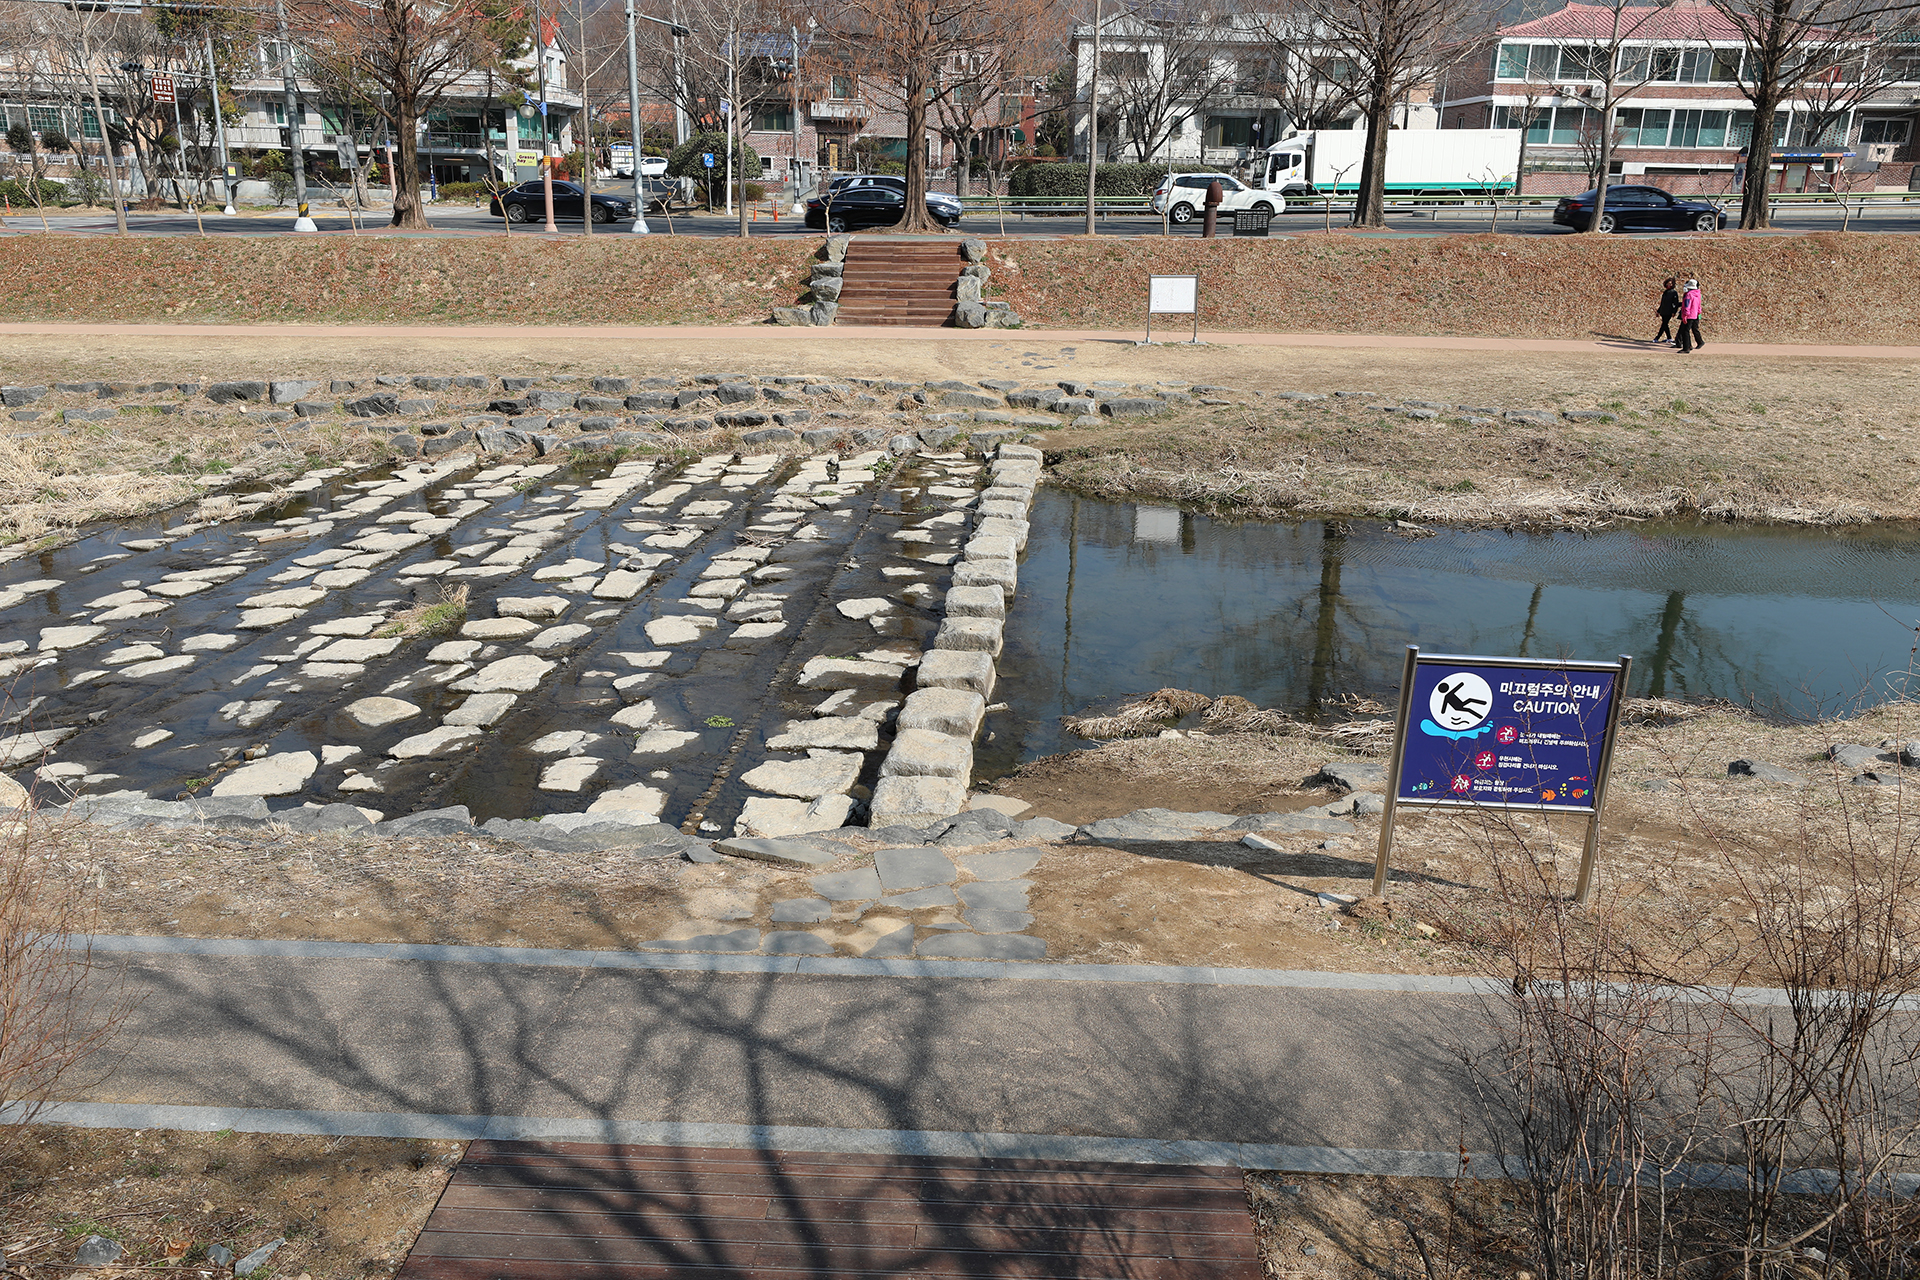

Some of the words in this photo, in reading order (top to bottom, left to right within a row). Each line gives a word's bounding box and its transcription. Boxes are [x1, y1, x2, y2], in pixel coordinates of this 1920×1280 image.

[1499, 682, 1568, 698] 미끄럼주의
[1572, 684, 1600, 700] 안내
[1513, 700, 1580, 715] CAUTION
